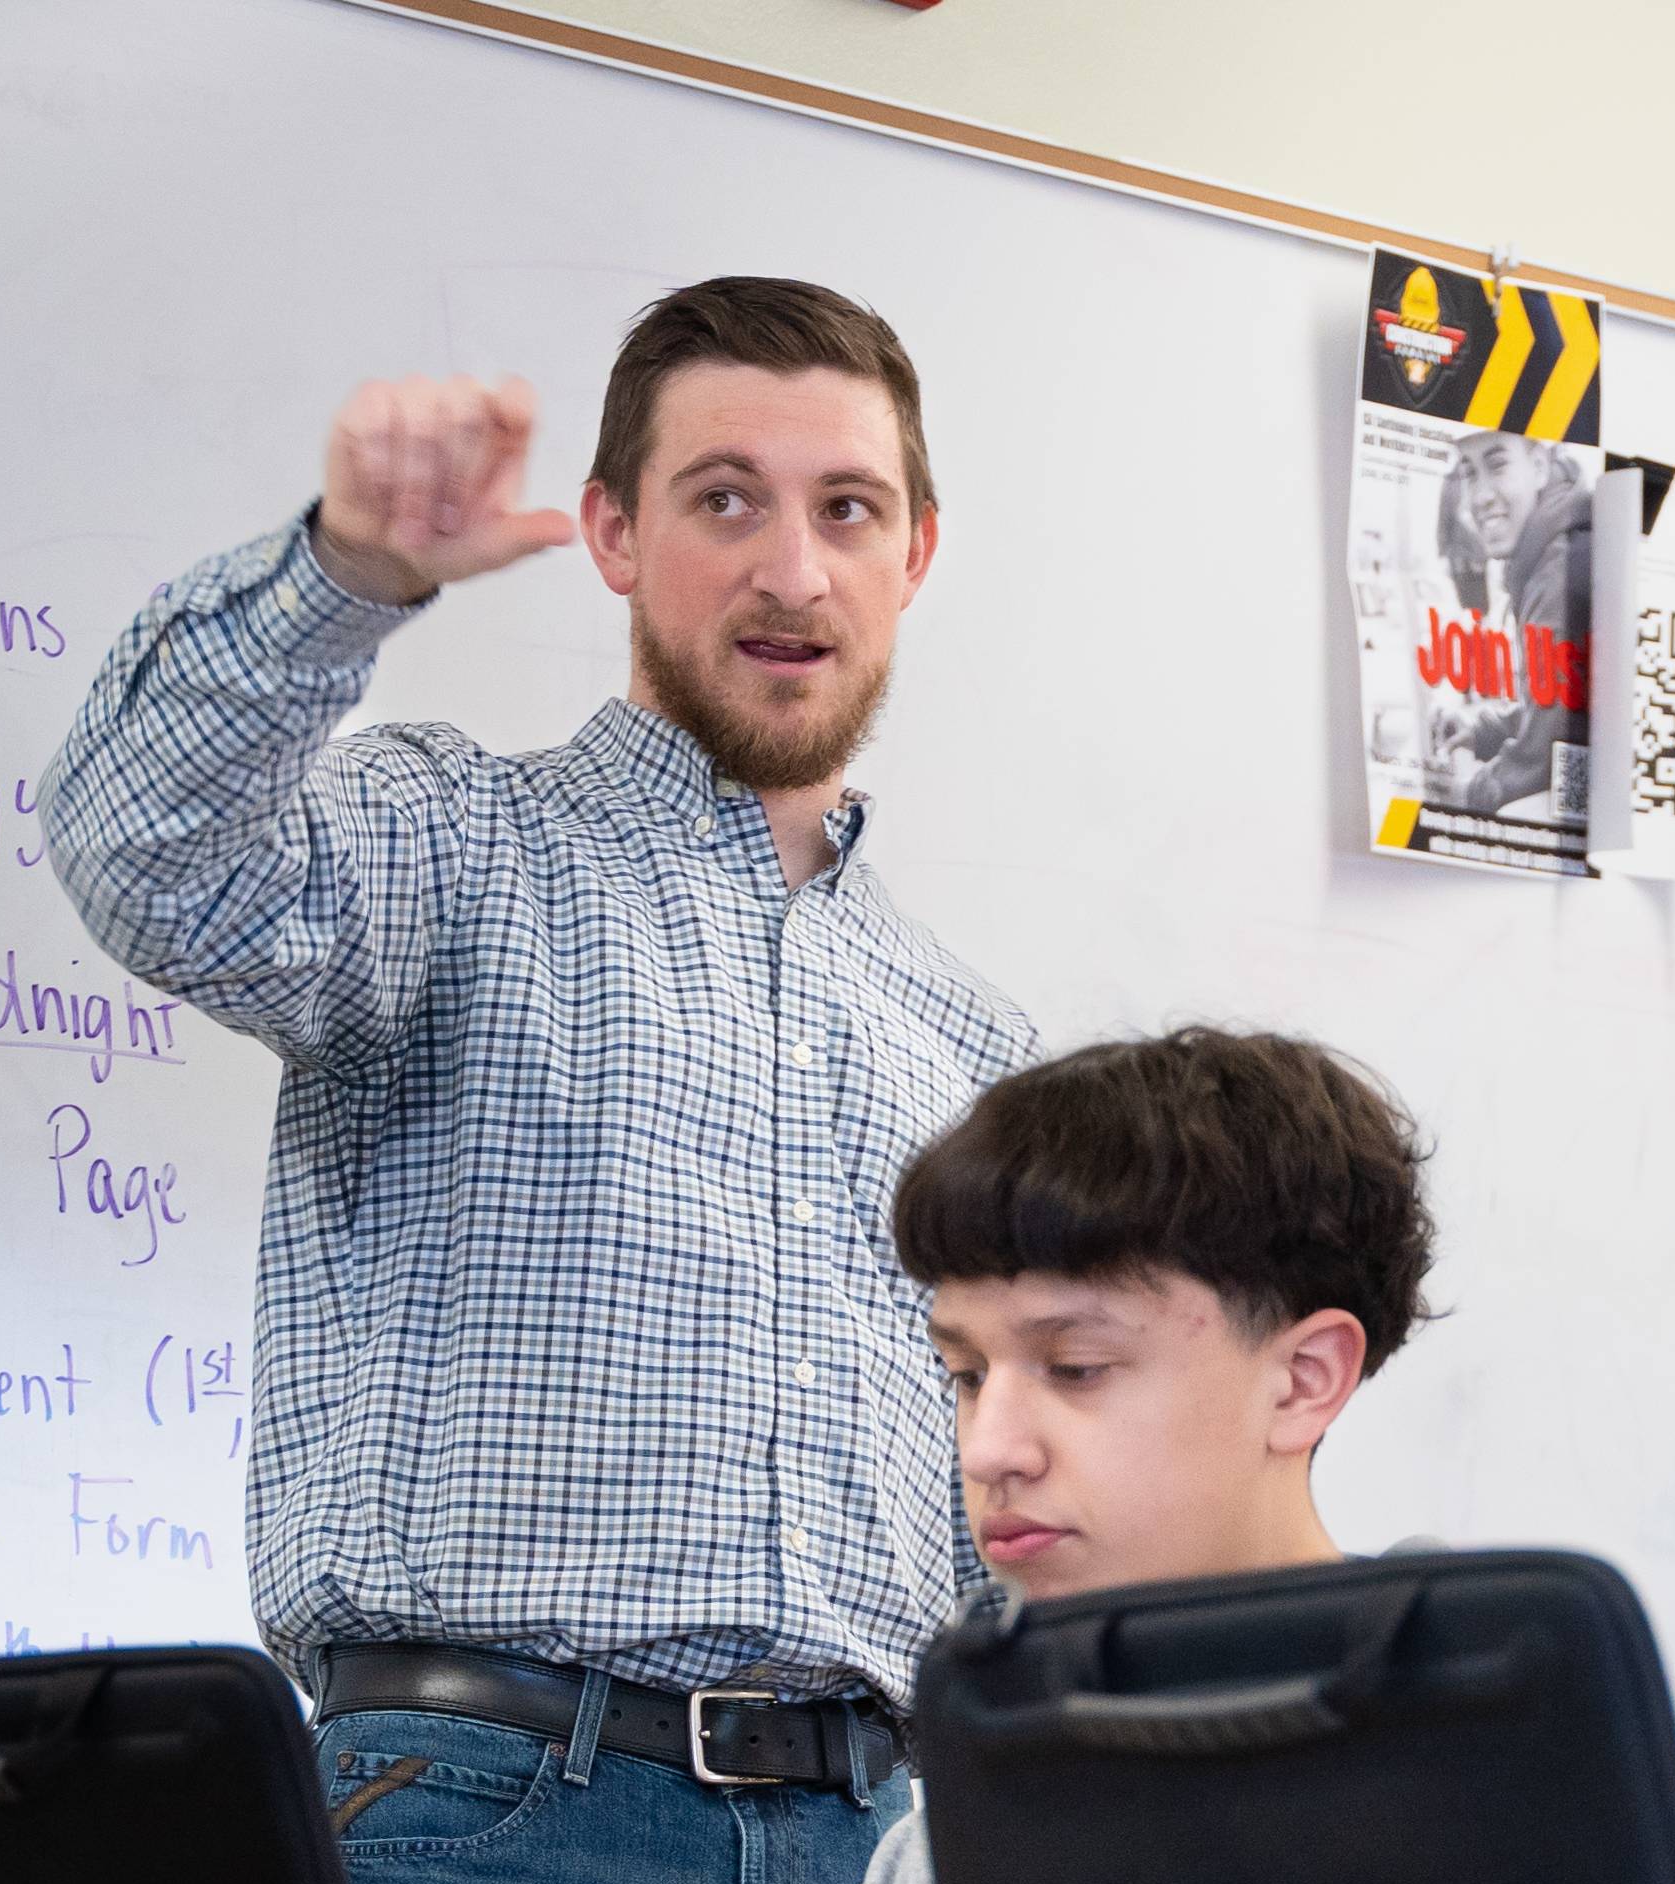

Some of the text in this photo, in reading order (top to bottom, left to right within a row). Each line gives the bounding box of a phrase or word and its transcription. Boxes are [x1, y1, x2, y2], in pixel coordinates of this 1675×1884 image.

[1417, 607, 1592, 711] Join Us
[47, 1104, 187, 1268] Page
[67, 1471, 213, 1570] Form
